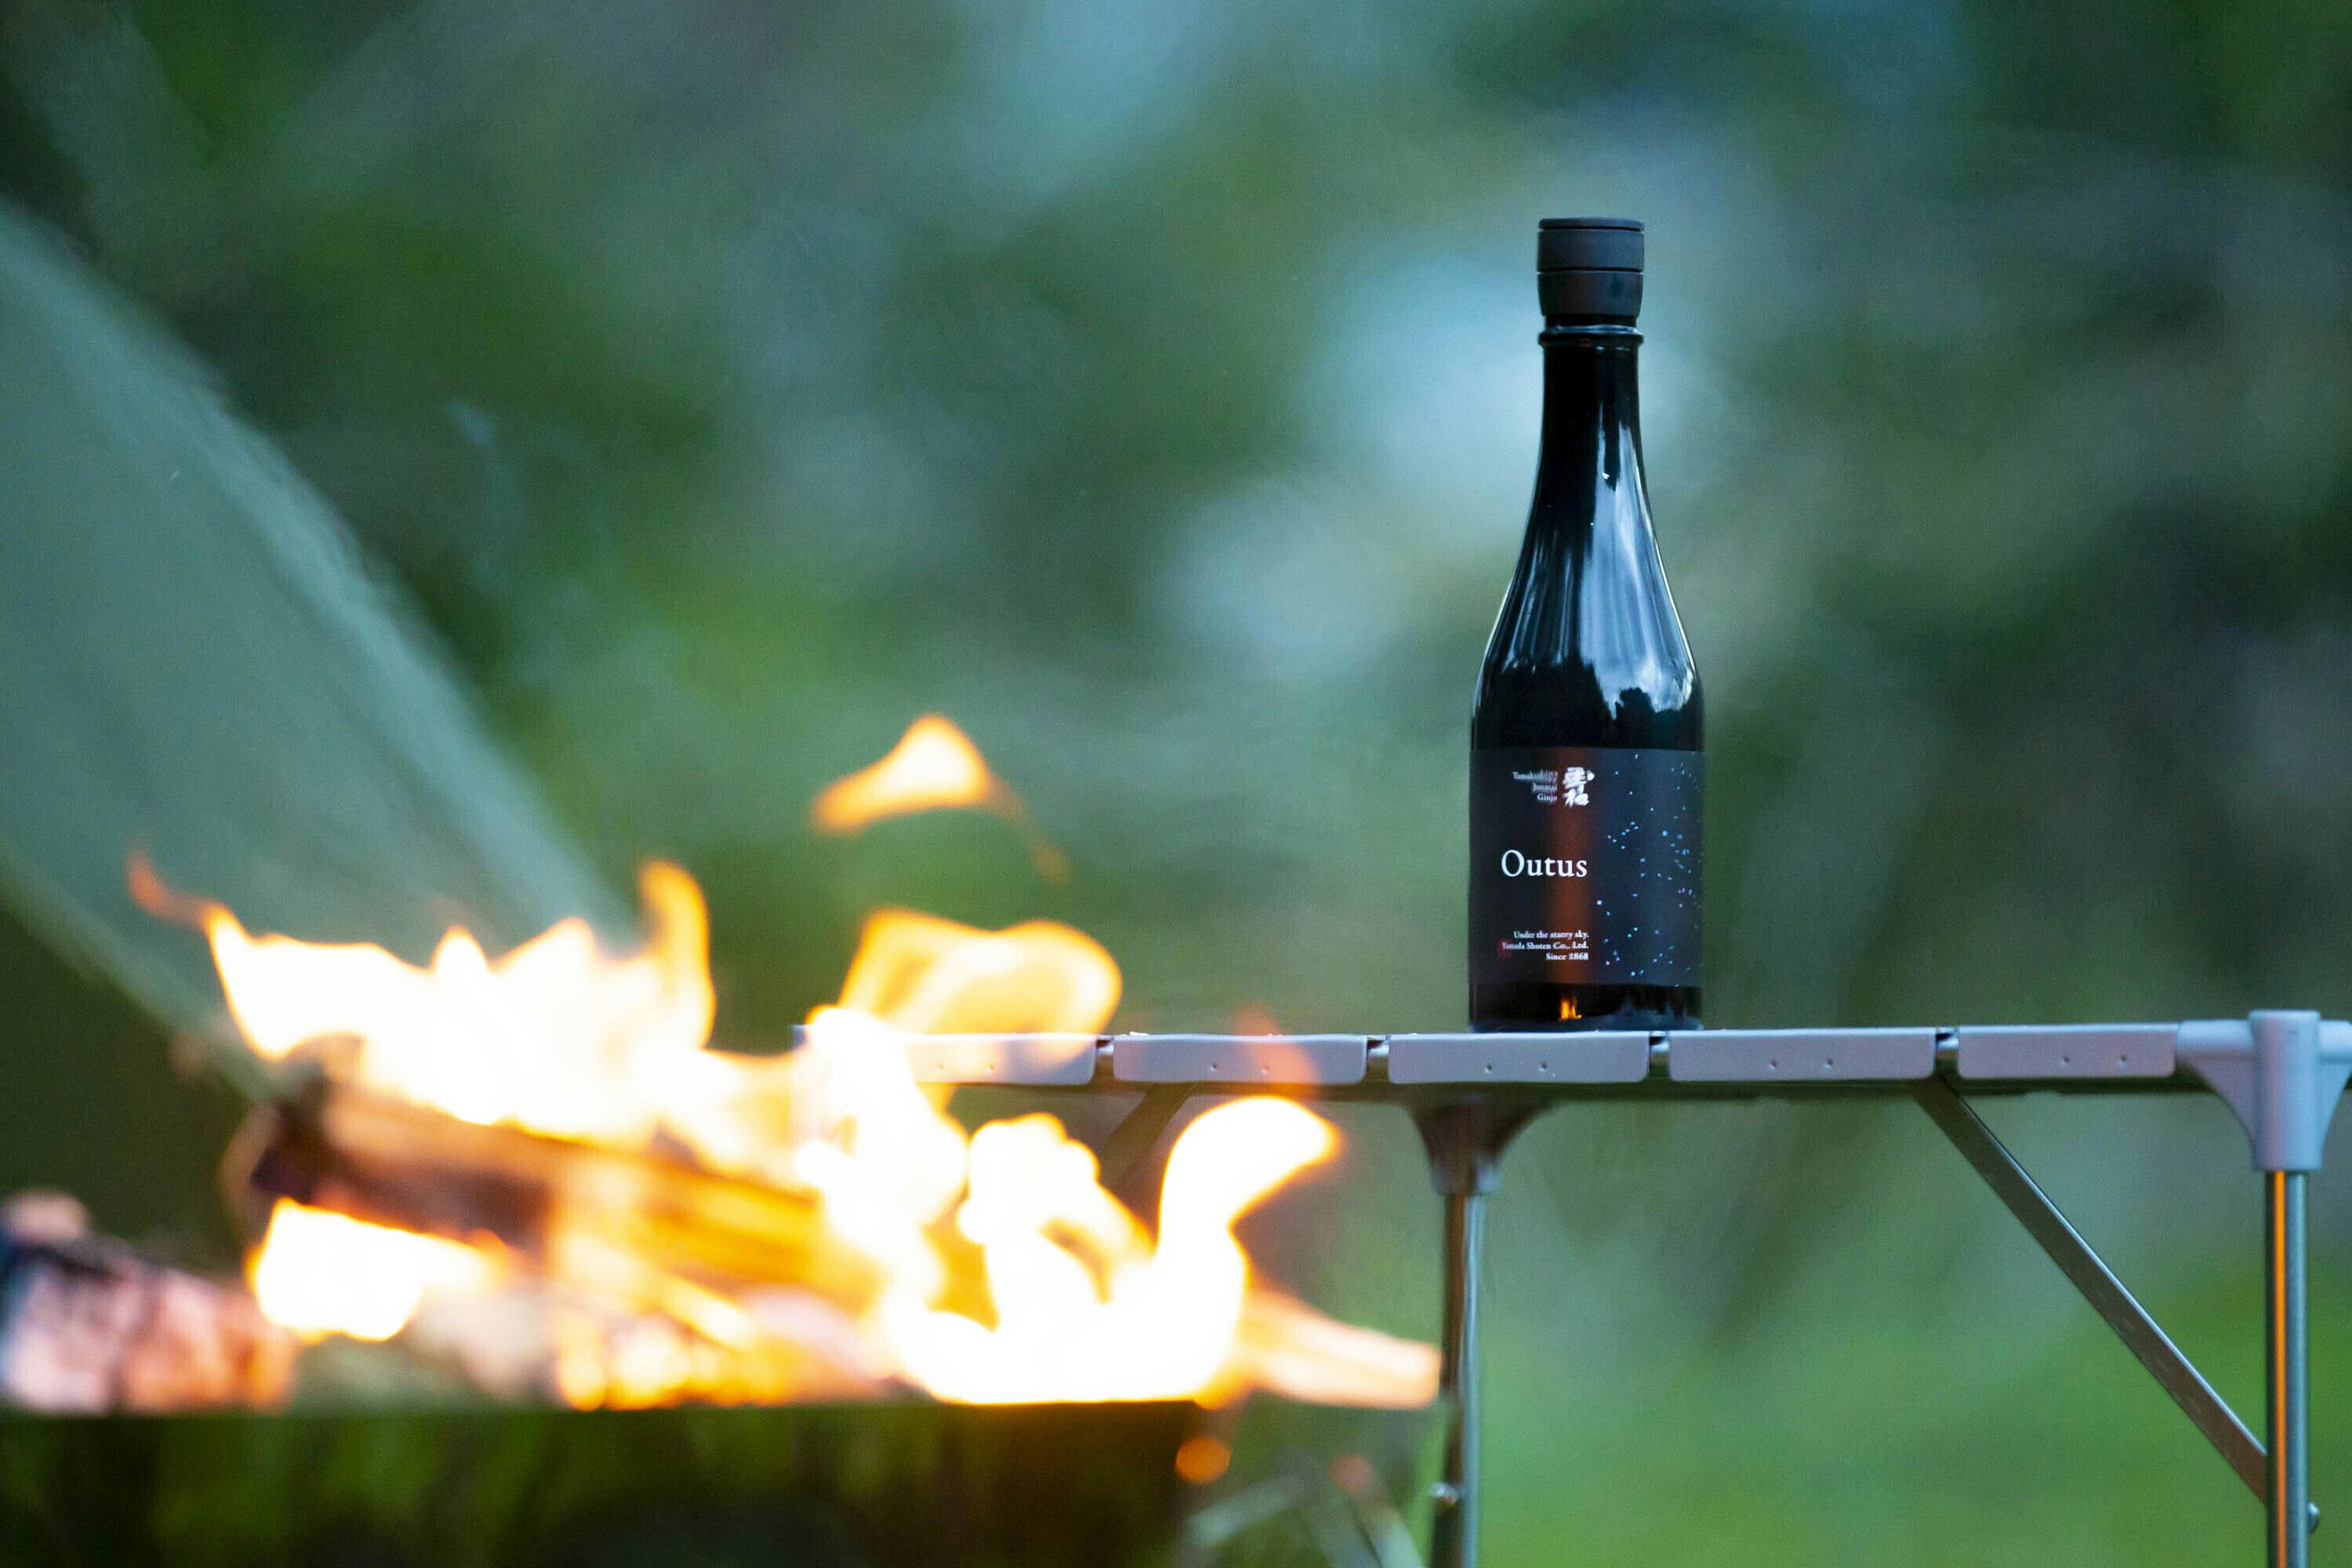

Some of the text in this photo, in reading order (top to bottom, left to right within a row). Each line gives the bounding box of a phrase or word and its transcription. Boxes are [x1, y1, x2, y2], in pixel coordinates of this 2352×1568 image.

[1537, 793, 1558, 803] Ginjo
[1501, 849, 1588, 877] Outus
[1513, 930, 1589, 940] Under the starry sky.
[1572, 941, 1589, 949] Ltd.
